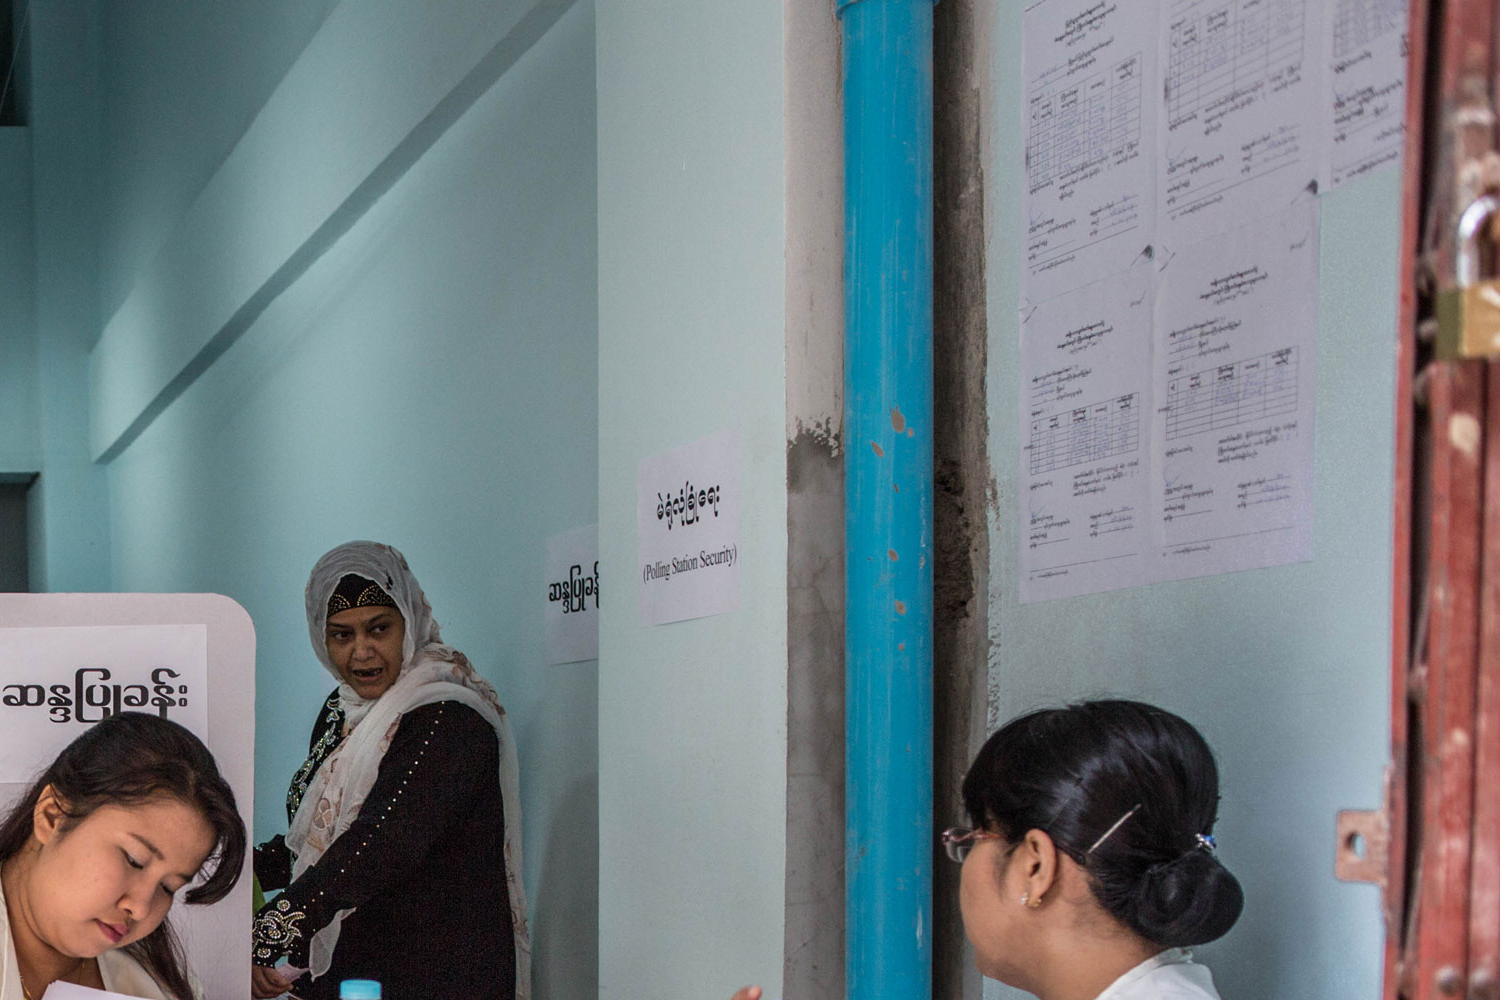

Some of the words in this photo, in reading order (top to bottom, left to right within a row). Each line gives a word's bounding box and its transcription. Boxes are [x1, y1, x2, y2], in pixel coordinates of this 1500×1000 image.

[656, 480, 720, 530] မဲရုံလုံခြုံရေး
[548, 560, 599, 614] ဆန္ဒပြုခန်
[643, 560, 671, 585] (Polling
[672, 554, 698, 575] Station
[700, 543, 736, 568] Security)
[2, 667, 188, 723] ဆန္ဒပြုခန်း
